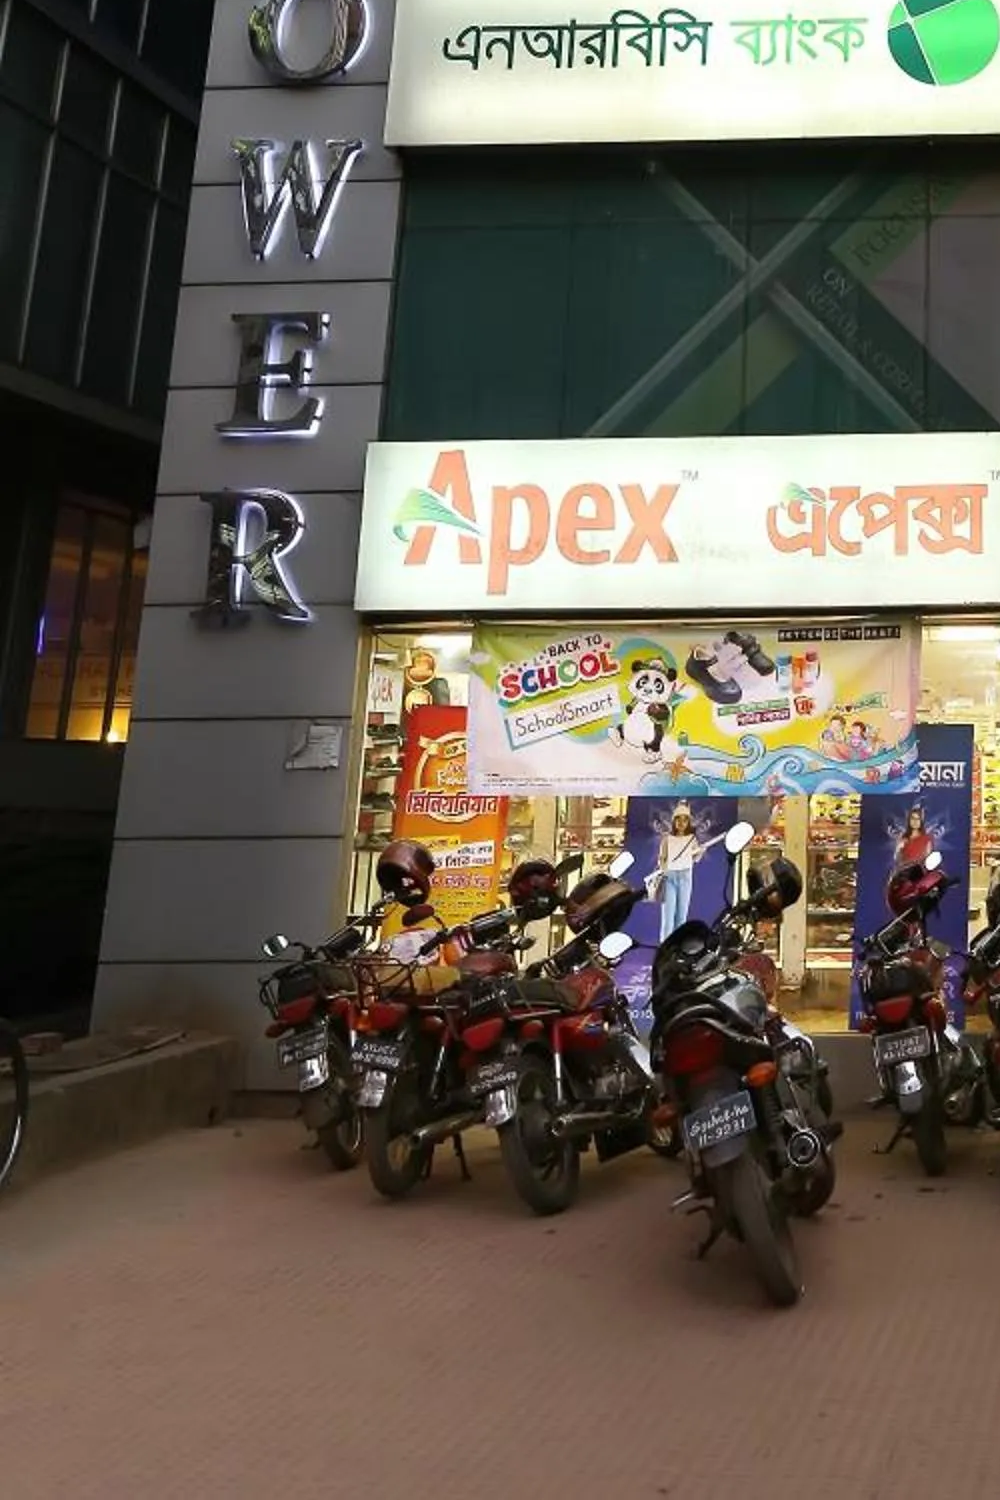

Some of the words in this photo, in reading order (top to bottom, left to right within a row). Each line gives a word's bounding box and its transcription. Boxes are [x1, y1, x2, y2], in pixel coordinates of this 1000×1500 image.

[442, 8, 714, 70] এনআরবিসি
[729, 12, 868, 65] ব্যাংক
[402, 447, 682, 597] Apex
[766, 483, 989, 557] এপেক্স
[501, 651, 619, 699] SCHOOL
[547, 640, 580, 657] BACK
[585, 633, 602, 647] TO
